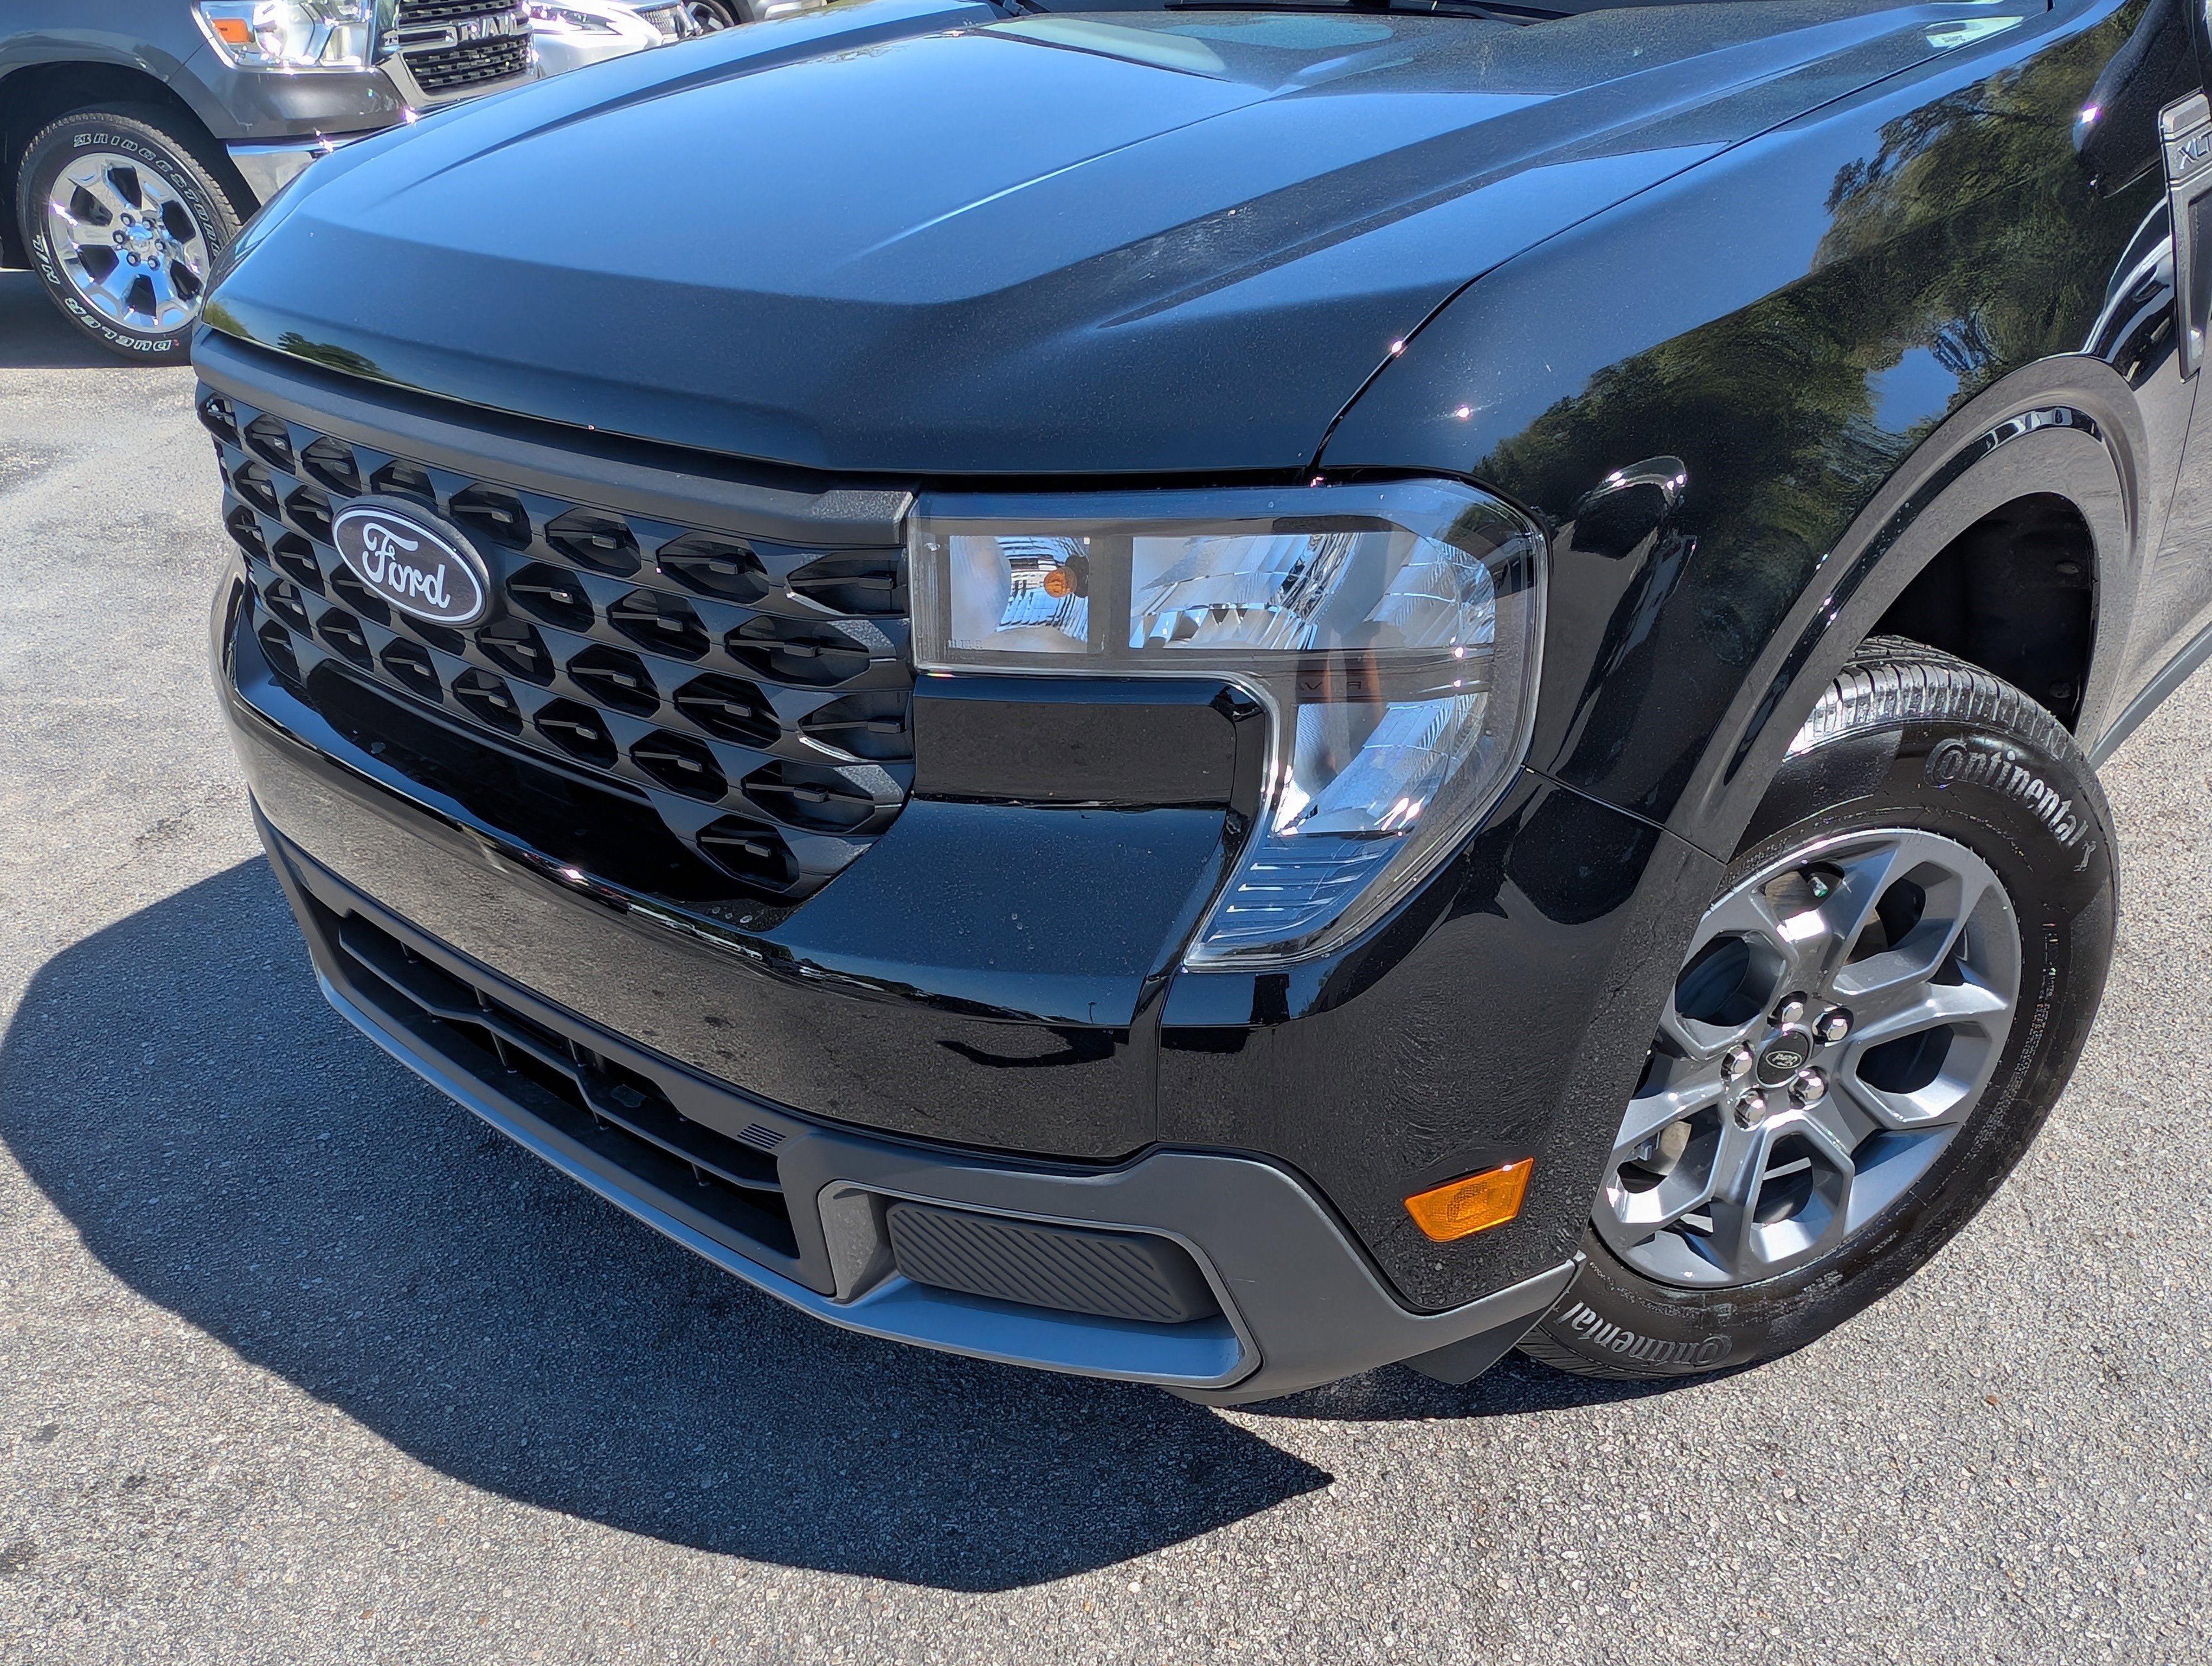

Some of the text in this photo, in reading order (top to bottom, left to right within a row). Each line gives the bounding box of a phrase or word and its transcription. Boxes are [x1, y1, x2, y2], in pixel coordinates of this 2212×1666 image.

[458, 11, 519, 42] RAM
[65, 297, 172, 351] DUELER
[362, 522, 451, 608] Ford
[1925, 738, 2089, 850] Continental
[1553, 1300, 1733, 1368] Continental
